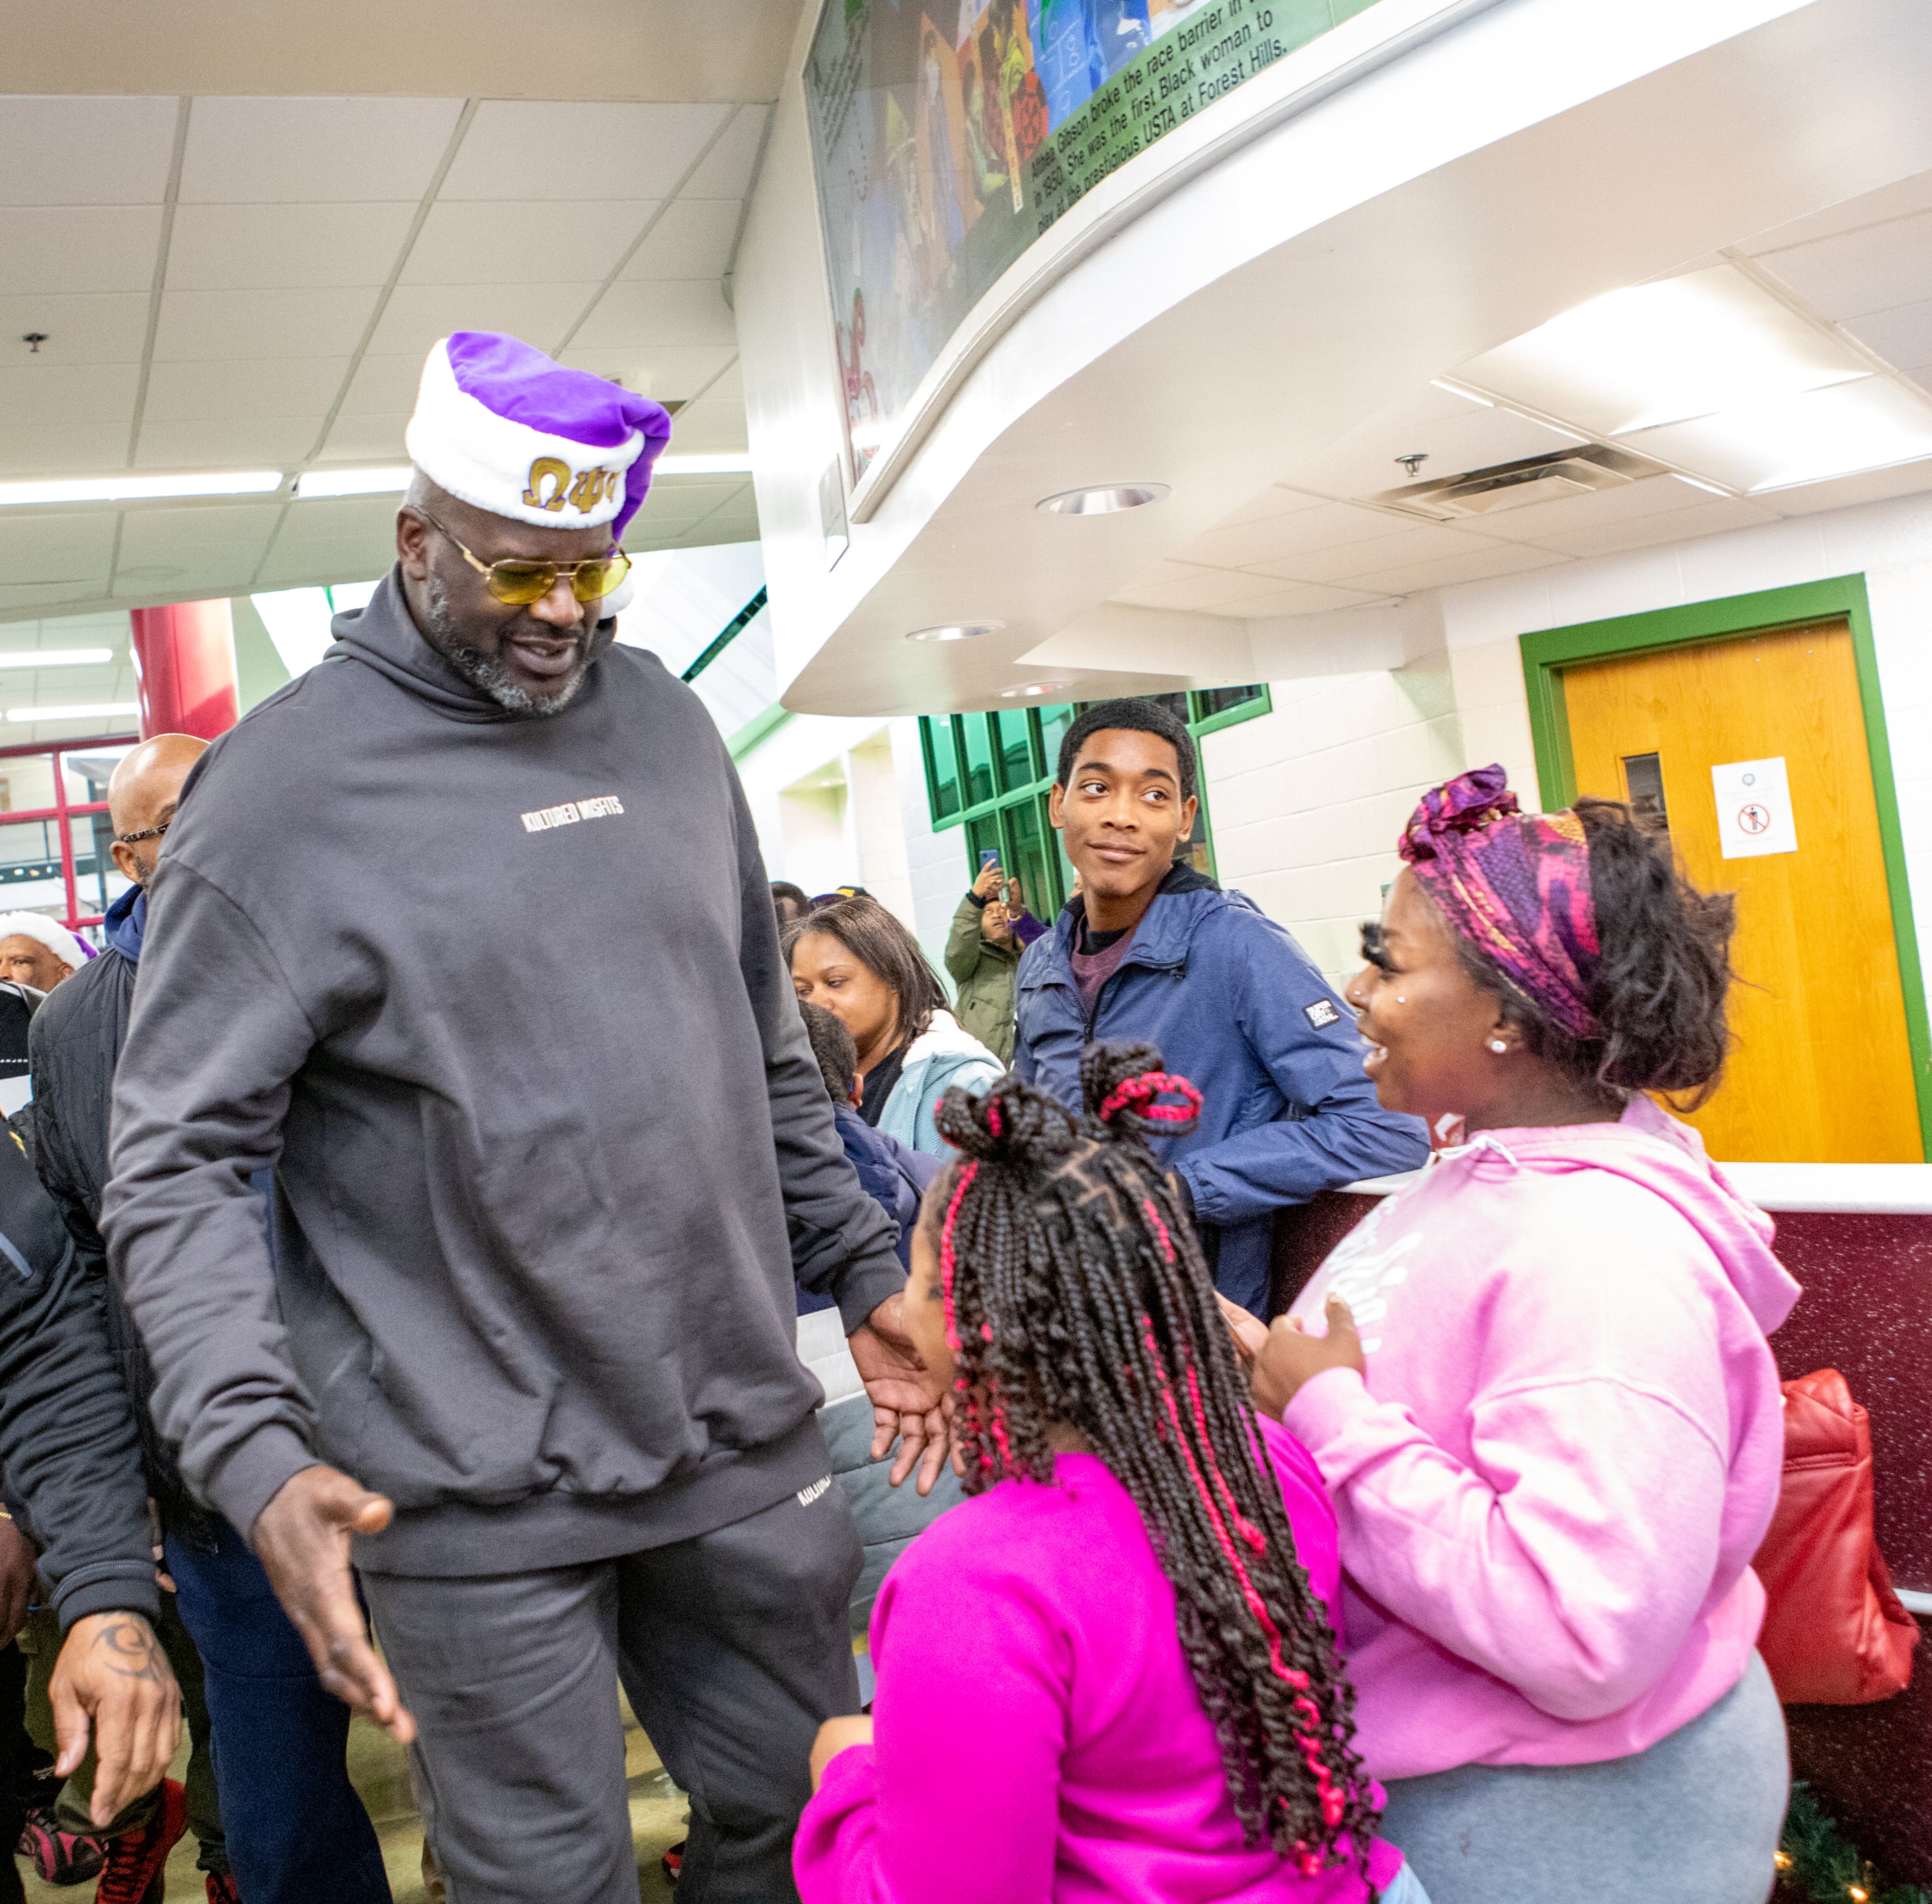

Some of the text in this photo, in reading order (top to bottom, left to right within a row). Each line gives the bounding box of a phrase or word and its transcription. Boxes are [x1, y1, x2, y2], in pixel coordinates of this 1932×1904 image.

[1067, 150, 1085, 176] She
[1087, 130, 1107, 157] was
[1109, 114, 1128, 137] the
[1131, 87, 1156, 121] first
[1159, 59, 1196, 100] Black
[1200, 24, 1252, 69] woman
[1257, 10, 1272, 31] to
[1084, 136, 1141, 192] prestigious
[1143, 105, 1176, 143] USTA
[1181, 93, 1195, 118] at
[1198, 59, 1245, 106] Forest
[1249, 38, 1287, 72] Hills.
[1089, 87, 1120, 122] broke
[1123, 69, 1143, 94] the
[1146, 45, 1173, 76] race
[1177, 7, 1223, 51] barrier
